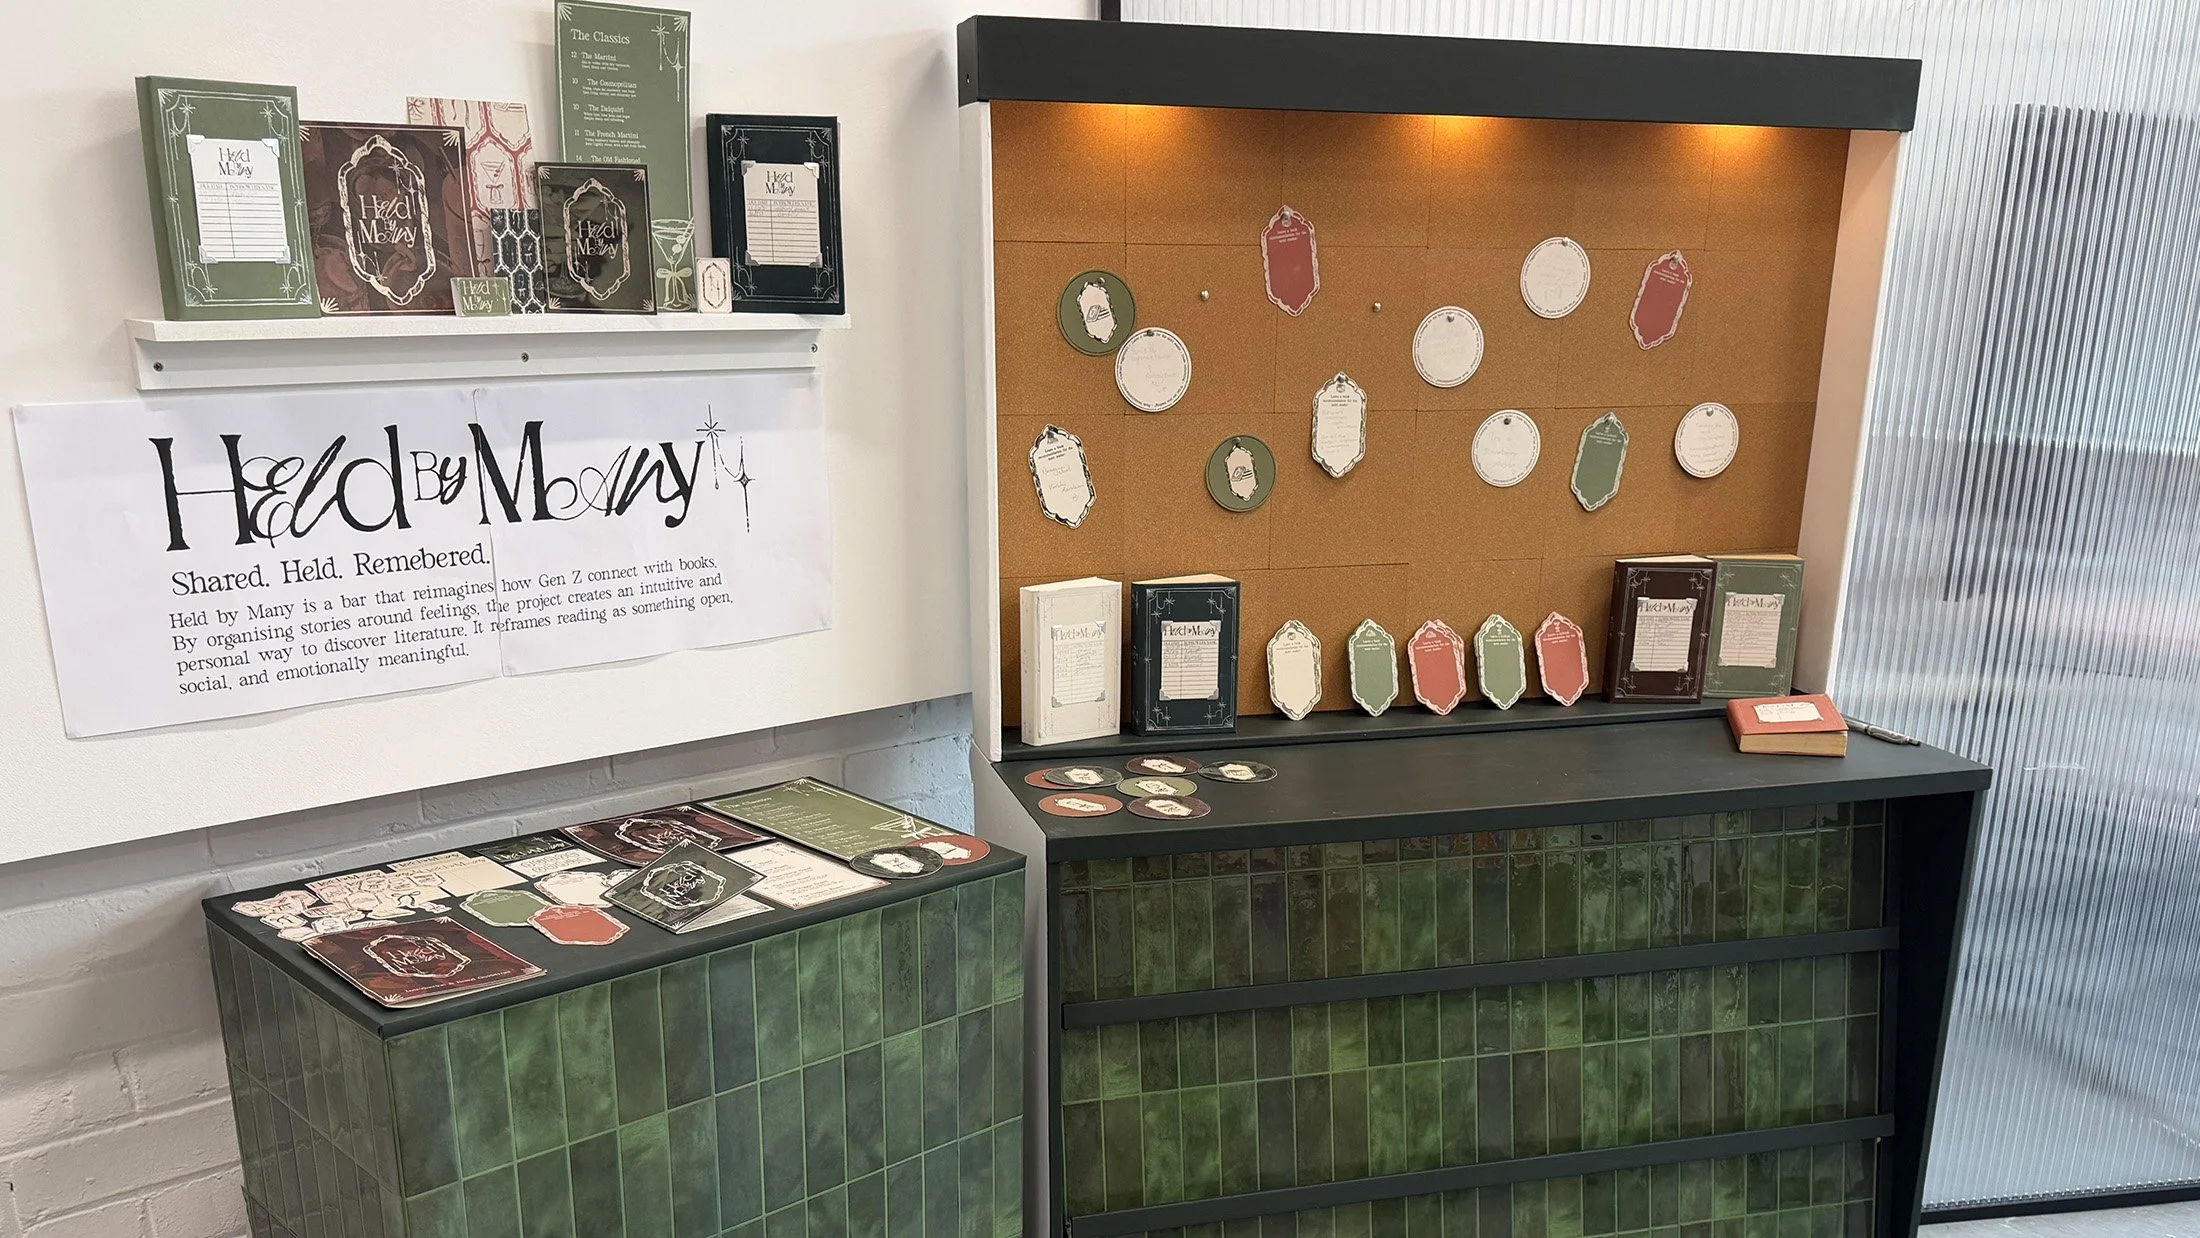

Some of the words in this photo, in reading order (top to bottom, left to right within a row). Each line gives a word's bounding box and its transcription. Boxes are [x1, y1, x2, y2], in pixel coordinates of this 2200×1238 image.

[571, 28, 590, 41] The
[593, 31, 631, 45] Classics
[594, 53, 617, 61] Martini
[587, 79, 598, 87] The
[588, 104, 599, 112] The
[359, 194, 412, 220] Held
[577, 220, 615, 238] Held
[149, 425, 412, 552] Held
[172, 564, 270, 596] Shared.
[280, 556, 343, 585] Held.
[353, 543, 490, 577] Remebered.
[169, 611, 208, 628] Held
[216, 609, 238, 627] by
[247, 601, 295, 621] Many
[303, 599, 316, 613] is
[324, 601, 333, 610] a
[340, 595, 366, 608] bar
[375, 590, 405, 604] that
[413, 581, 495, 600] reimagines
[501, 579, 531, 592] how
[539, 574, 566, 587] Gen
[572, 570, 582, 584] Z
[588, 567, 638, 581] connect
[644, 560, 673, 574] with
[679, 556, 717, 570] books.
[172, 635, 197, 653] By
[207, 625, 294, 650] organising
[301, 619, 351, 635] stories
[358, 609, 413, 627] around
[420, 601, 480, 620] feelings,
[486, 599, 509, 612] the
[517, 594, 562, 613] project
[568, 590, 612, 603] creates
[618, 587, 634, 597] an
[640, 577, 694, 596] intuitive
[700, 573, 722, 587] and
[176, 652, 250, 676] personal
[258, 647, 292, 663] way
[302, 644, 317, 656] to
[325, 636, 386, 652] discover
[394, 626, 468, 644] literature.
[473, 620, 484, 634] It
[490, 616, 551, 632] reframes
[557, 608, 607, 624] reading
[613, 607, 626, 617] as
[632, 596, 695, 615] something
[701, 593, 733, 607] open,
[179, 675, 232, 694] social,
[239, 669, 269, 686] and
[276, 657, 369, 682] emotionally
[378, 643, 470, 667] meaningful.
